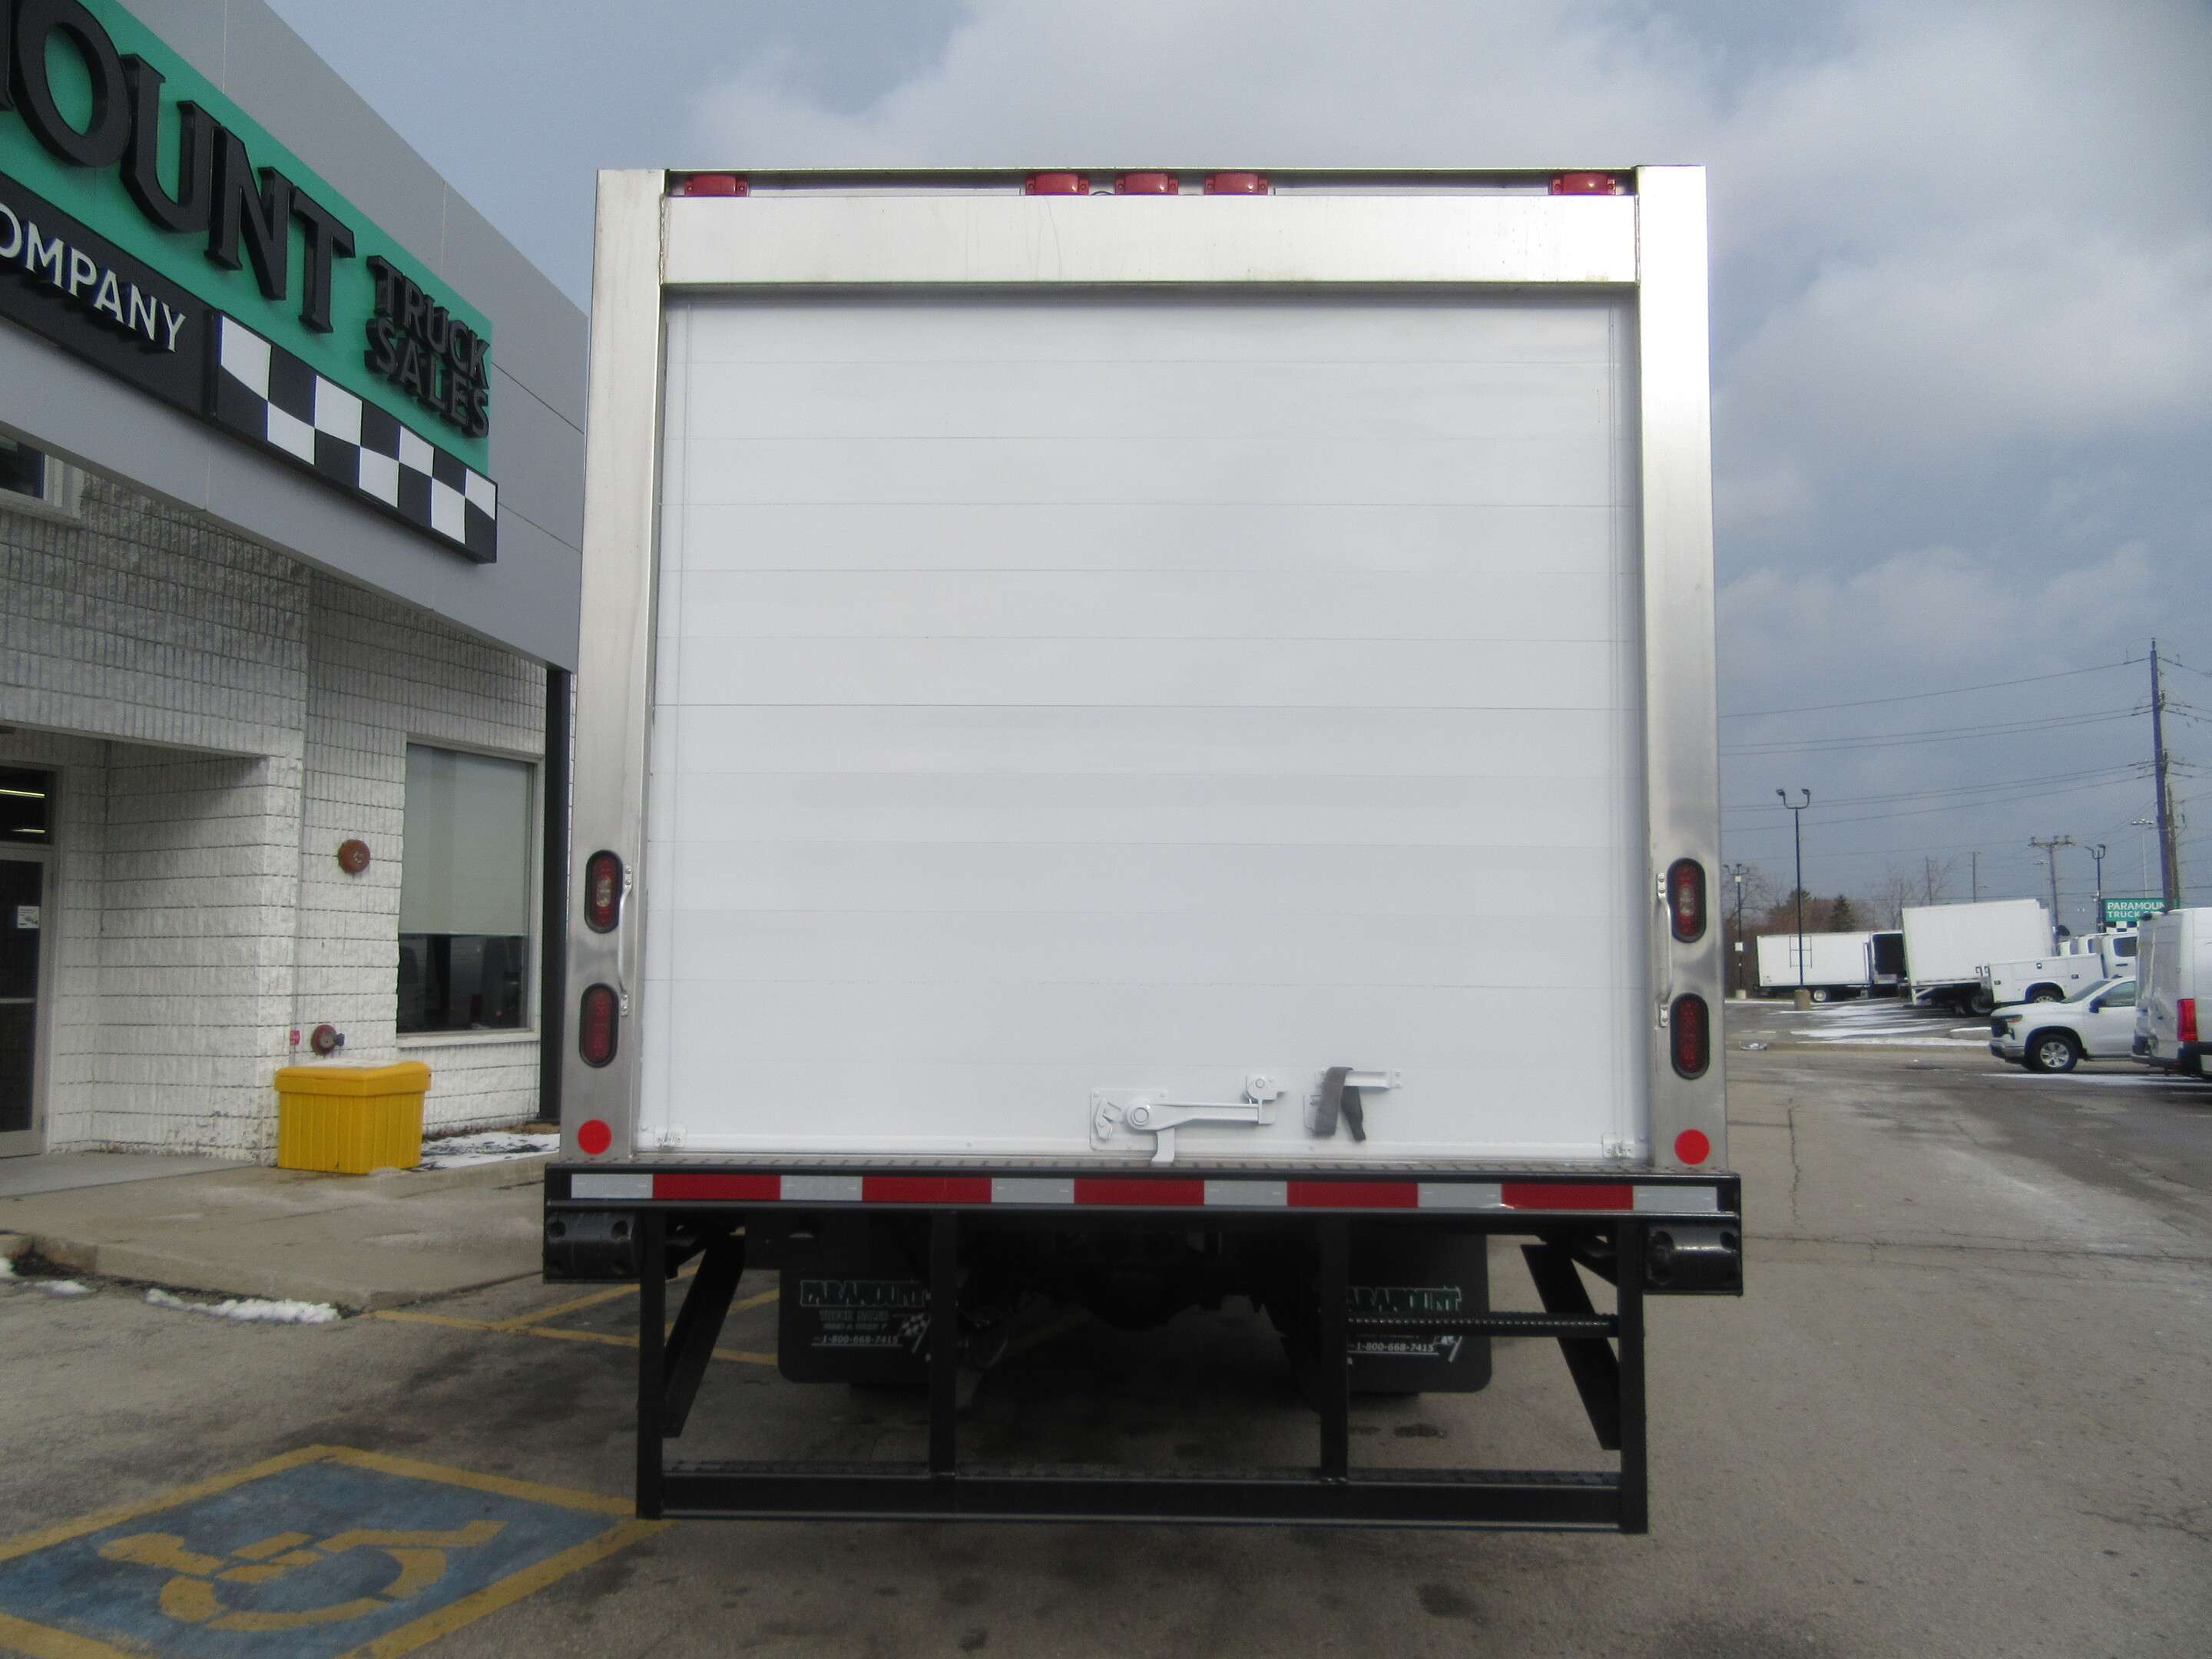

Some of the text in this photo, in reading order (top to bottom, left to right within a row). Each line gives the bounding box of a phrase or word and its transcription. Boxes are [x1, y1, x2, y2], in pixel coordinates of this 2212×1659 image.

[0, 0, 356, 333] OUNT
[363, 317, 489, 439] SALES
[365, 254, 492, 390] TRUCK
[2107, 902, 2165, 911] PARAMOUN
[1356, 1341, 1435, 1353] 1-800-668-7415
